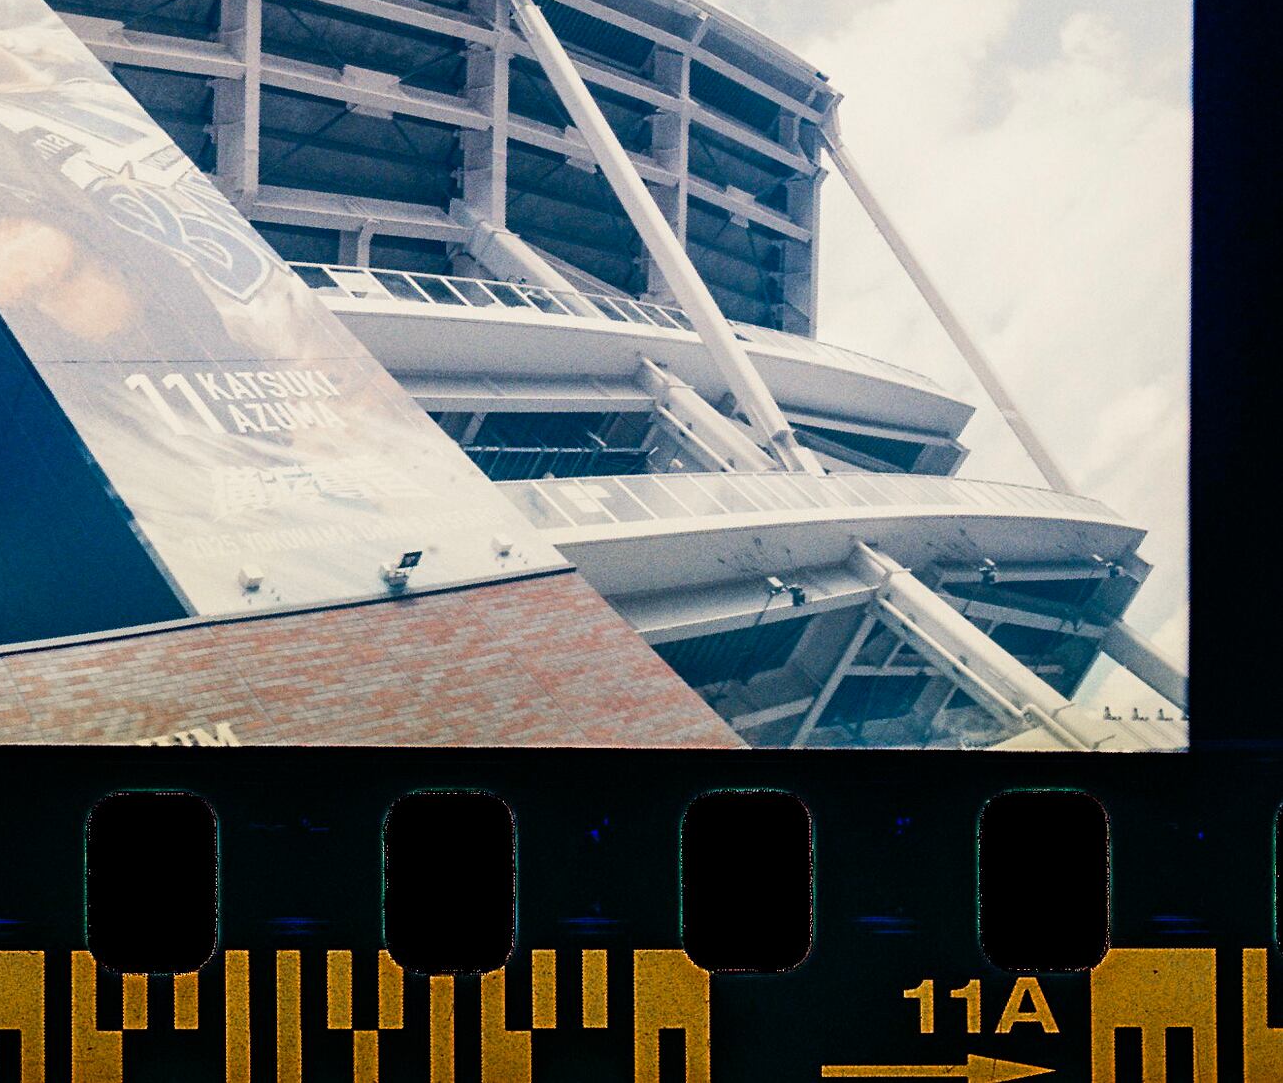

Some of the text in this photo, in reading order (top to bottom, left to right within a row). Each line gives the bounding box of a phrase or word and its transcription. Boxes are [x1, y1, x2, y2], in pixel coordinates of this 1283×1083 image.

[124, 370, 341, 435] 11 KATSUKI
[227, 401, 349, 433] AZUMA
[903, 975, 1060, 1034] 11A
